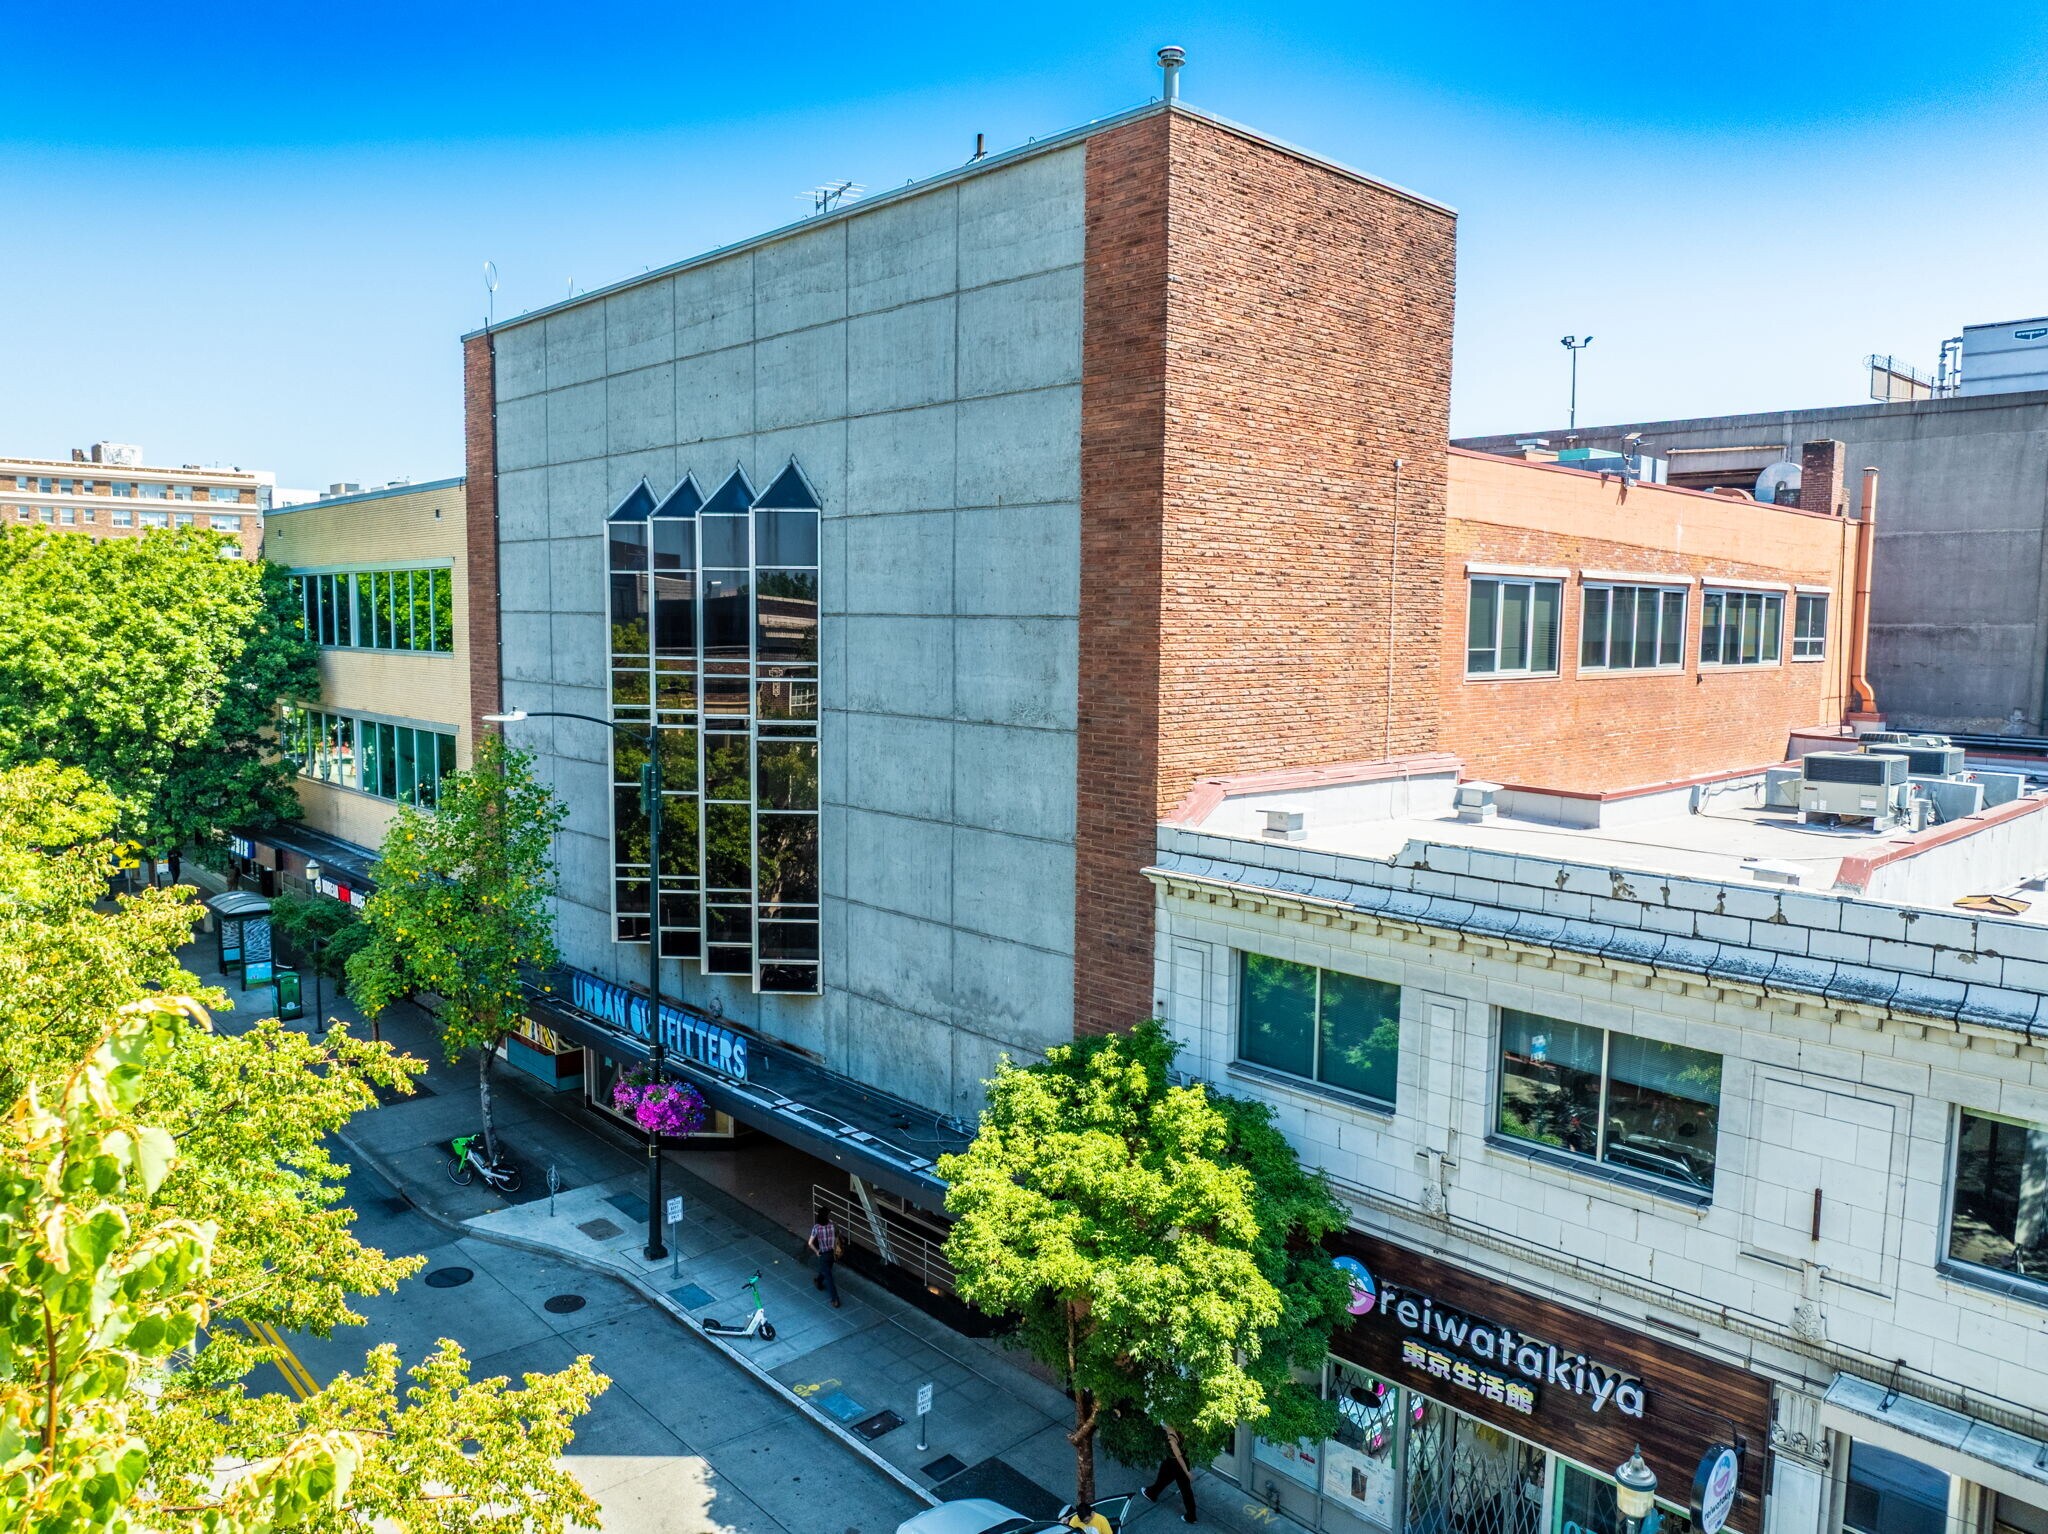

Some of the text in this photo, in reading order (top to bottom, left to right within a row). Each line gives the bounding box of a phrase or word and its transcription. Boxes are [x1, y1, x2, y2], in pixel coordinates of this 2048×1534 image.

[573, 974, 747, 1079] URBAN OUTFITTERS
[1380, 1290, 1645, 1418] reiwatakiya
[1402, 1340, 1534, 1415] 東京生活館
